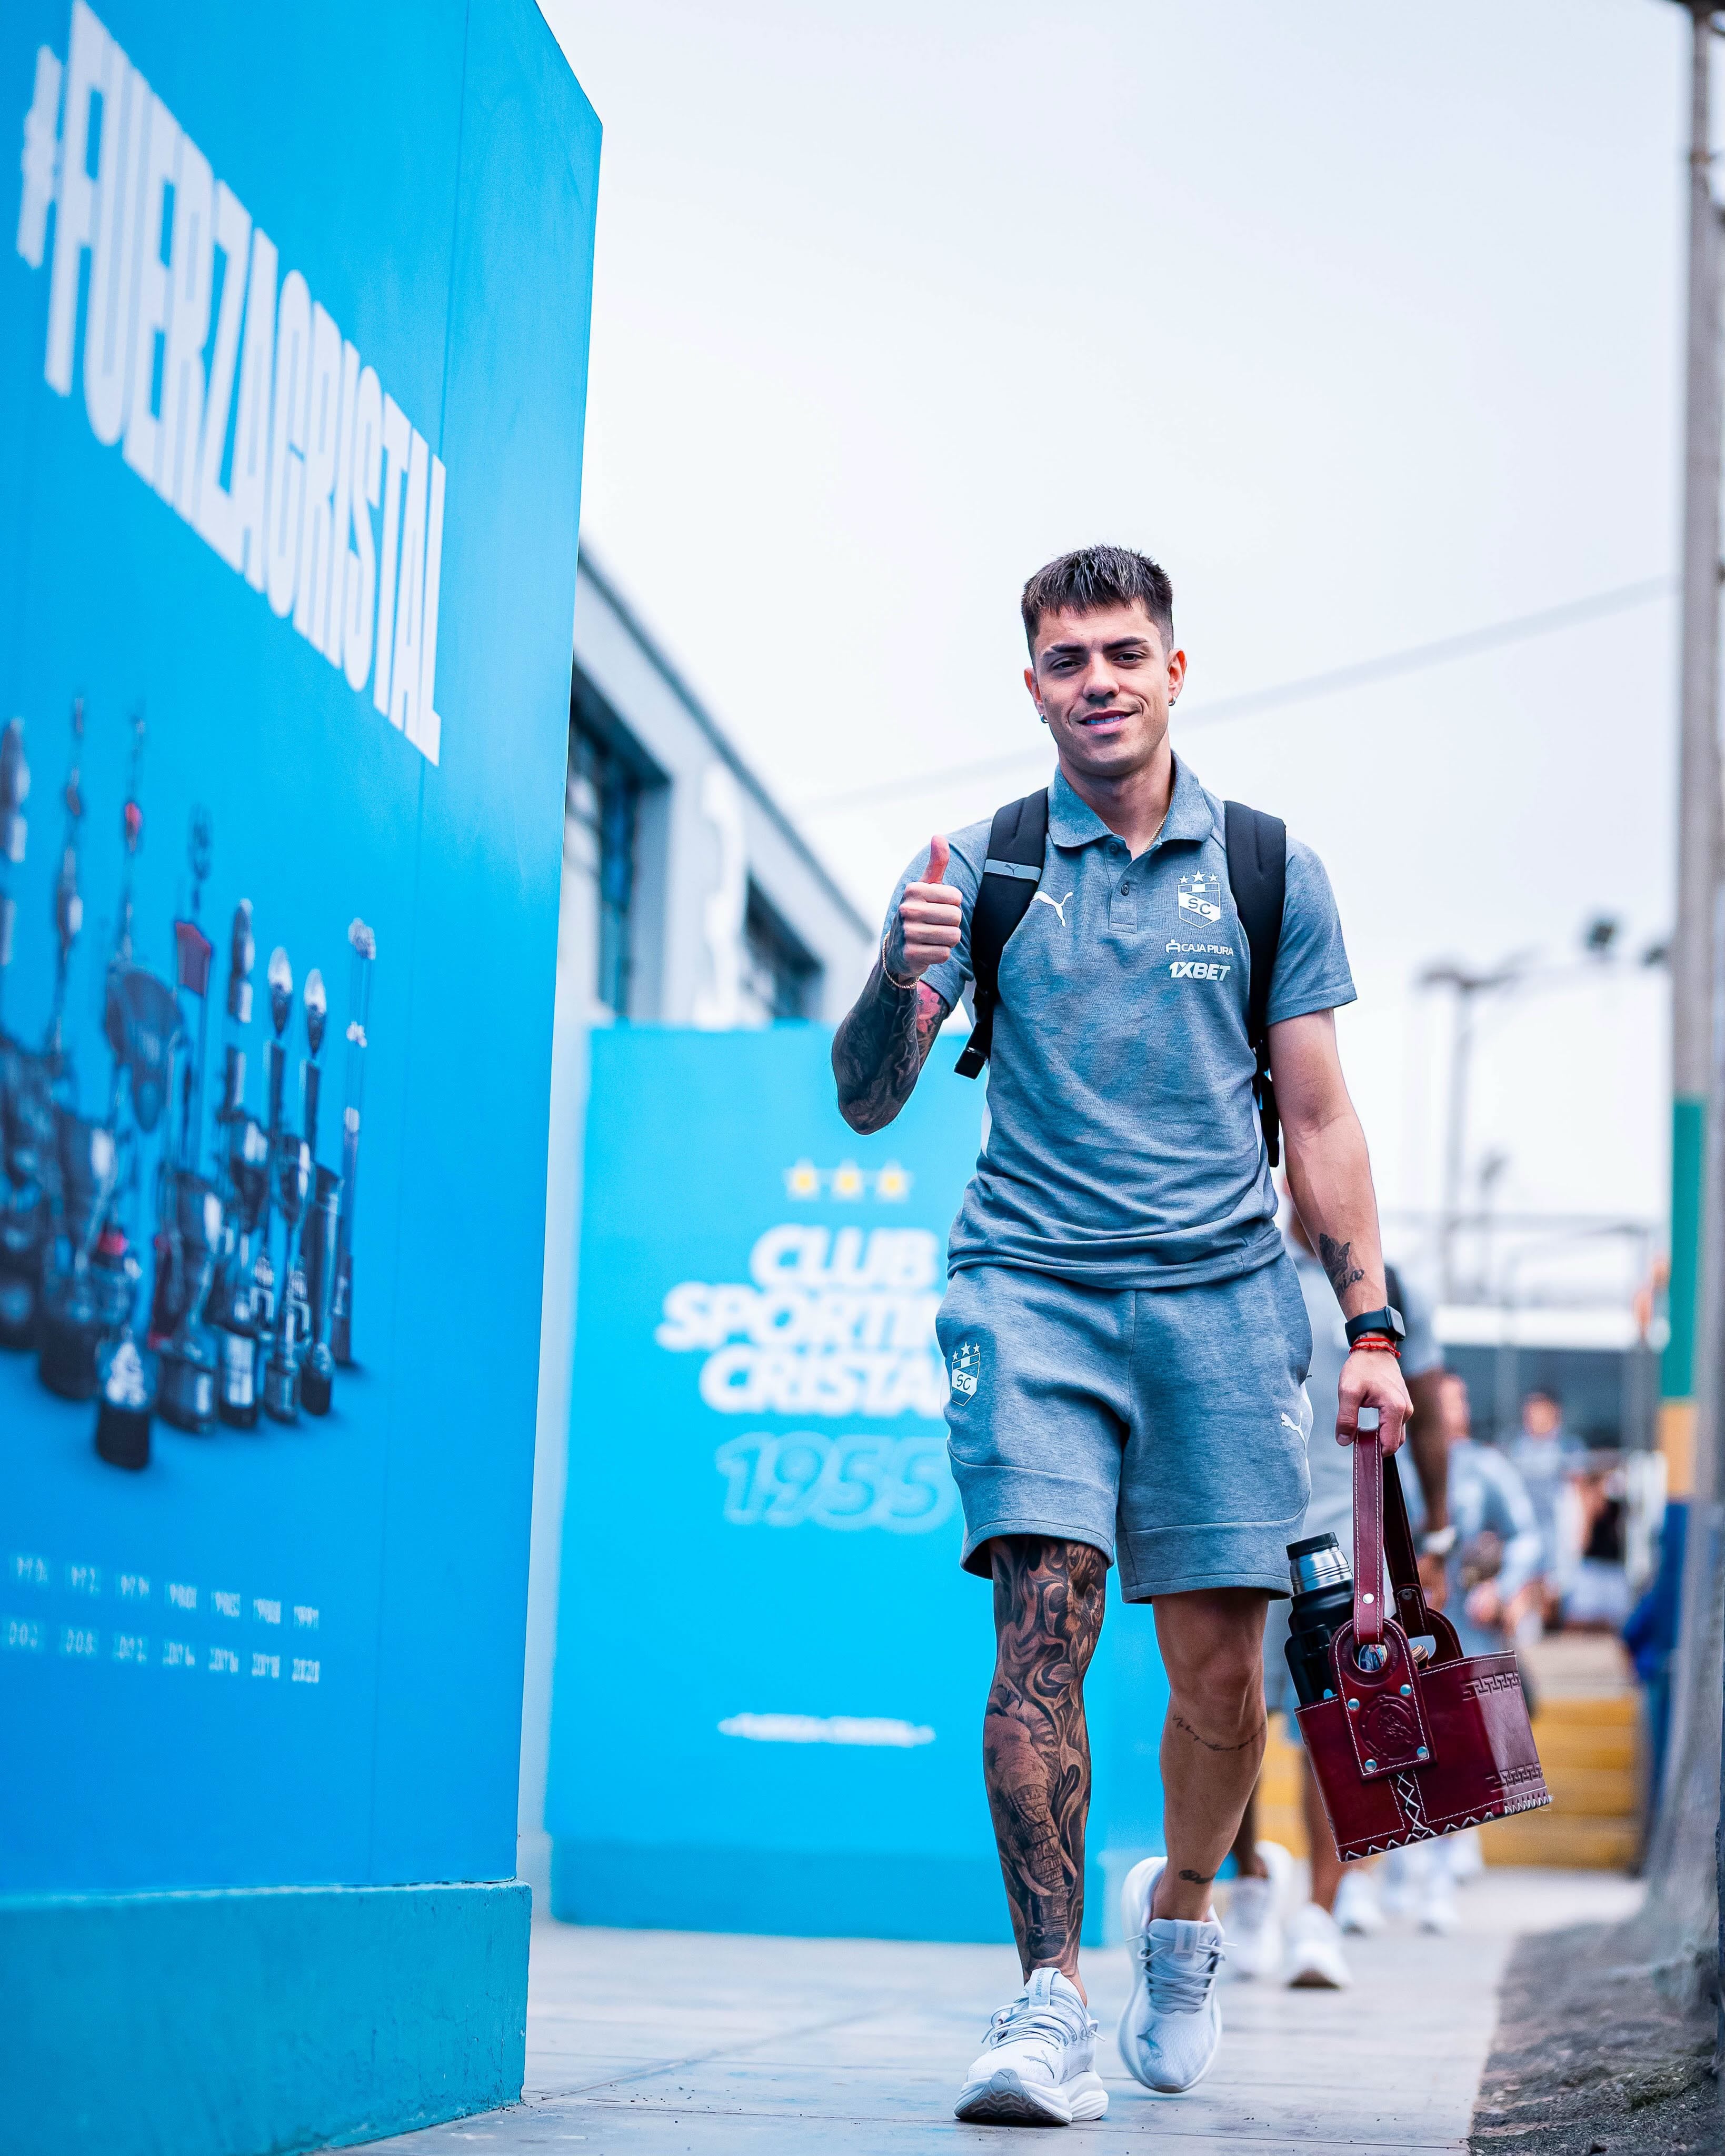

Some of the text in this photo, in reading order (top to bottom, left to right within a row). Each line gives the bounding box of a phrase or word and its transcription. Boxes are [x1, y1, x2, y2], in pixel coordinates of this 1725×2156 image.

[17, 0, 446, 767] #FUERZACRISTAL
[1188, 898, 1211, 915] SC
[1181, 943, 1234, 956] CAJA PIURA
[1169, 961, 1231, 981] 1XBET
[750, 1224, 939, 1287] CLUB
[699, 1343, 950, 1418] CRISTA
[956, 1374, 972, 1391] SC
[714, 1431, 957, 1533] 1955
